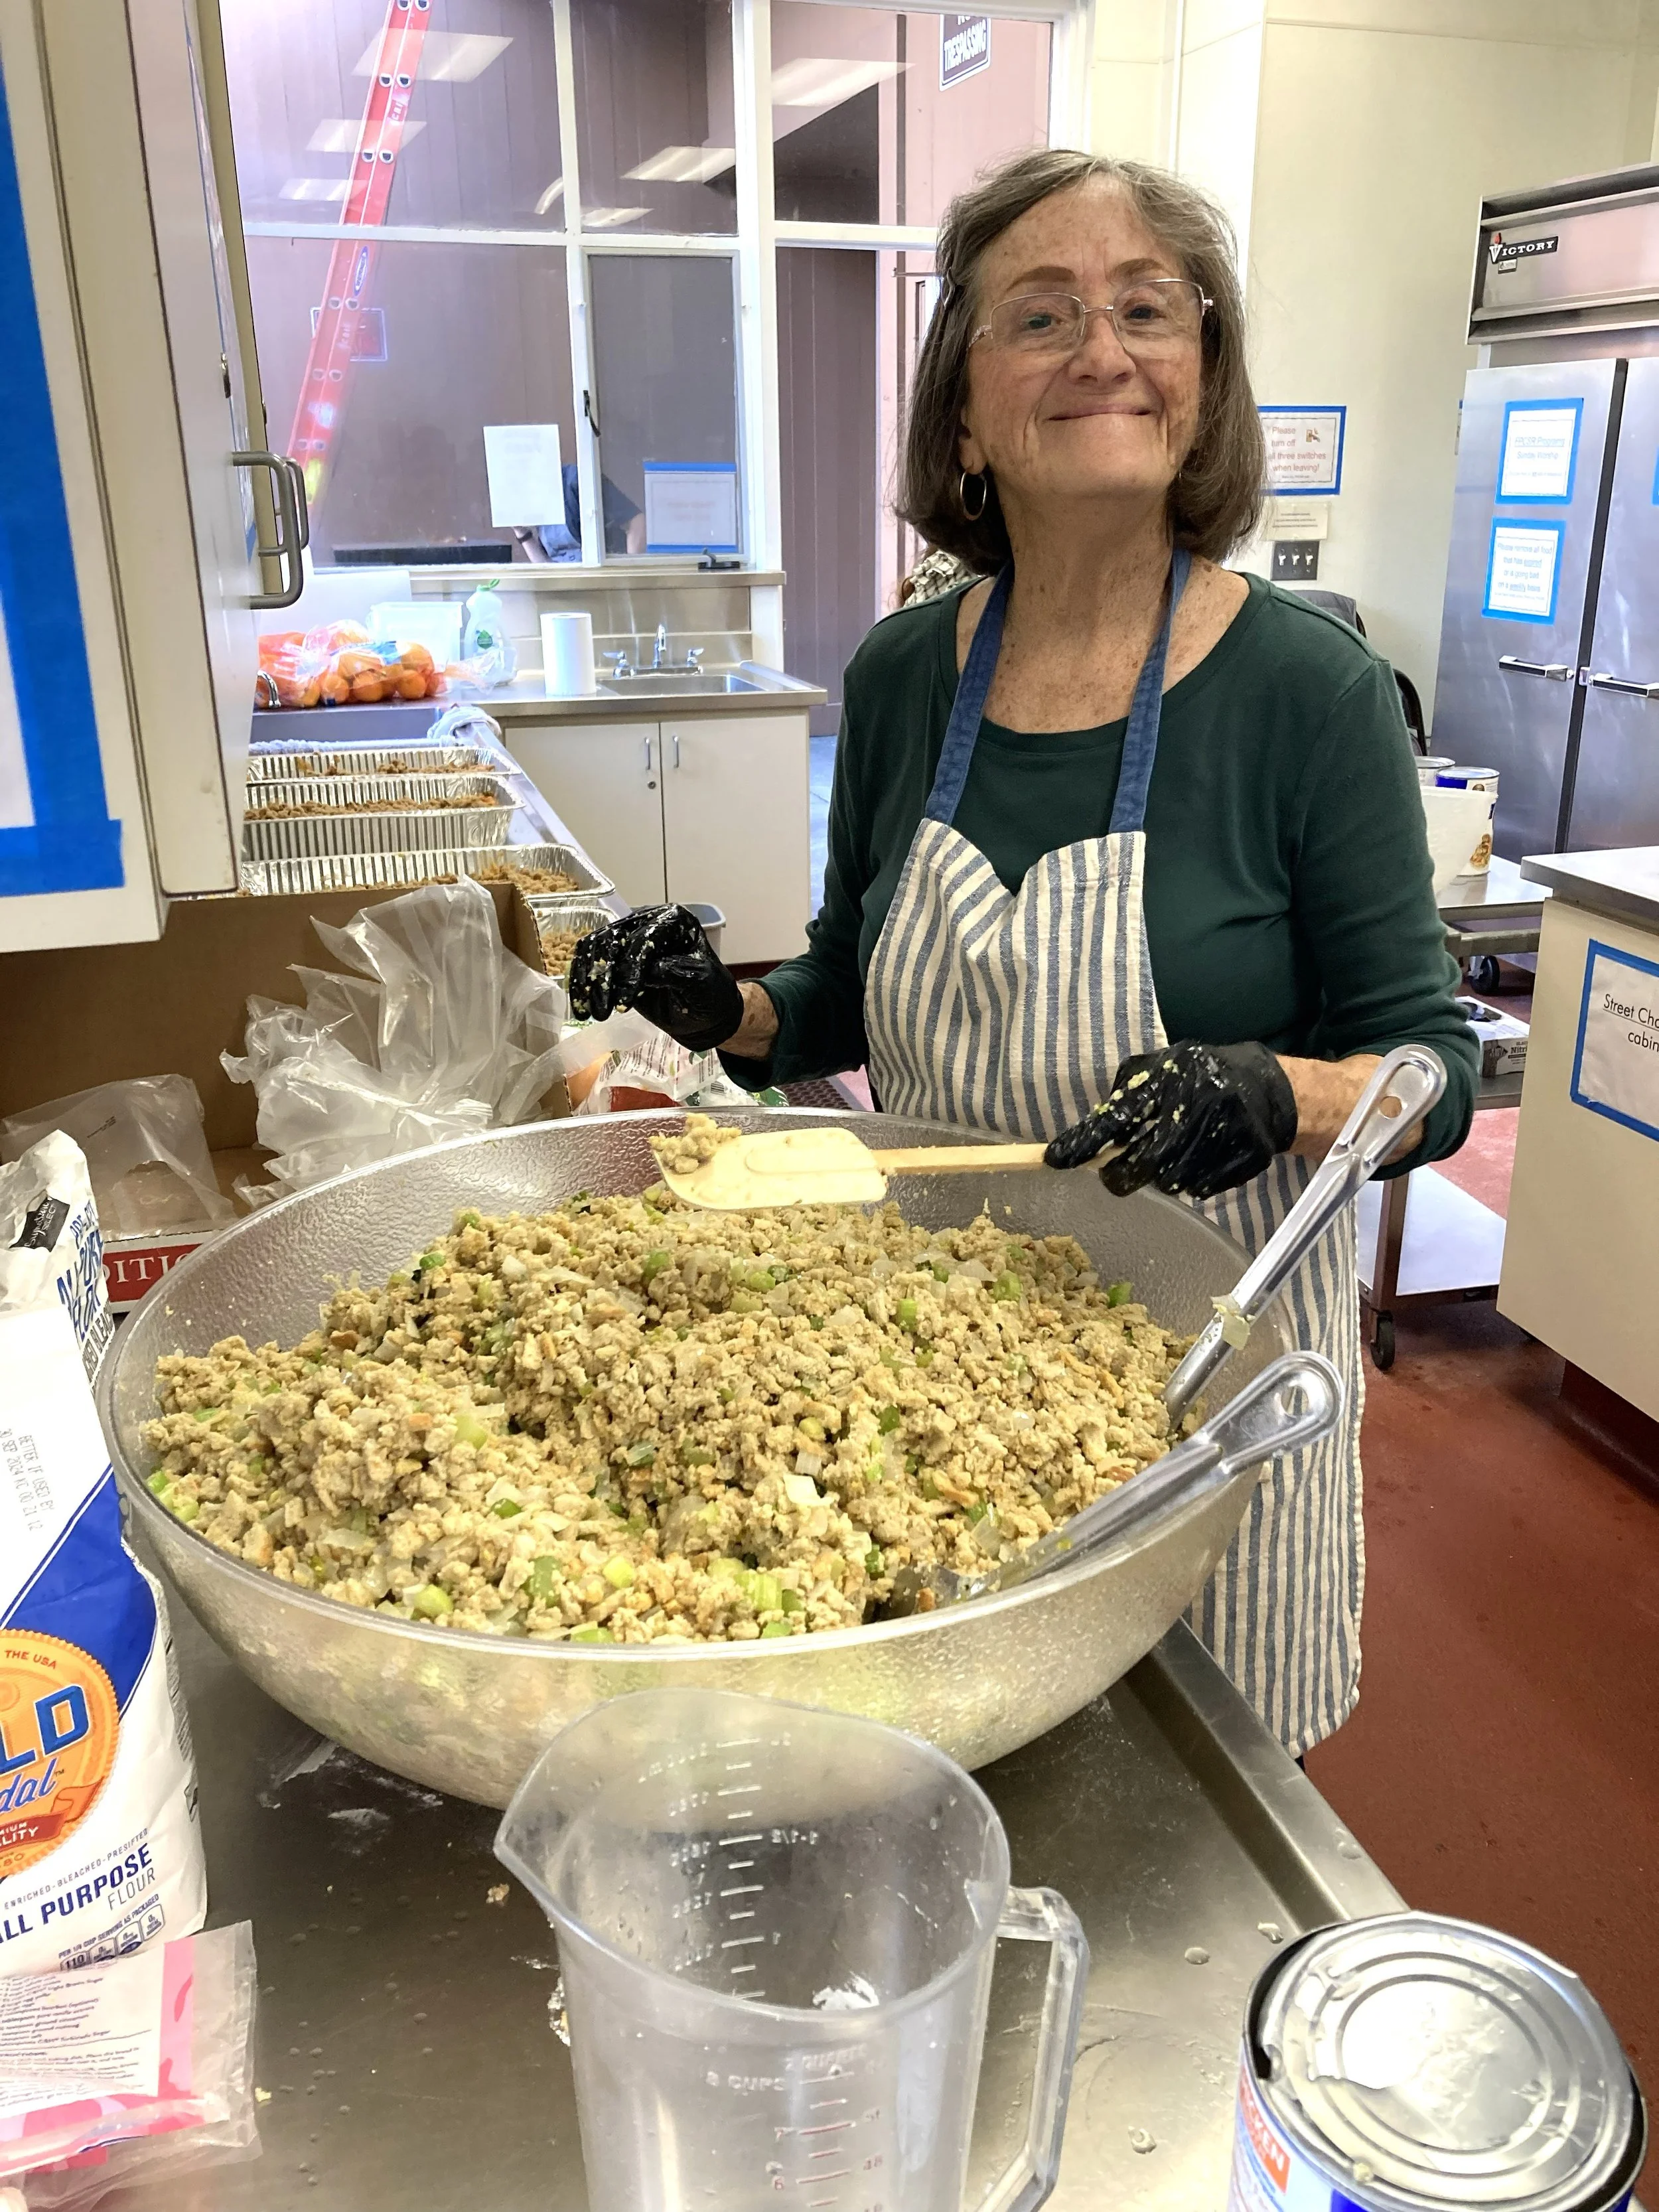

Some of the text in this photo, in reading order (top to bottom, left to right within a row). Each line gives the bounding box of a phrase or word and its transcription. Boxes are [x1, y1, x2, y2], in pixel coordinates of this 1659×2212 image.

[944, 19, 986, 72] TRESPASSING
[1488, 241, 1555, 263] VICTORY
[1272, 426, 1296, 435] Please
[1293, 464, 1319, 473] leaving!
[1603, 994, 1634, 1019] Street
[2, 1439, 18, 1452] SEP
[19, 1434, 38, 1463] BETTER
[28, 1465, 44, 1473] IF
[32, 1477, 50, 1498] USED
[5, 1649, 58, 1670] THE USA
[40, 1842, 153, 1925] PURPOSE
[108, 1866, 156, 1911] FLOUR
[83, 1937, 97, 1948] CUP
[98, 1921, 123, 1941] SERVING
[123, 1915, 131, 1925] AS
[131, 1893, 159, 1919] PACKAGED
